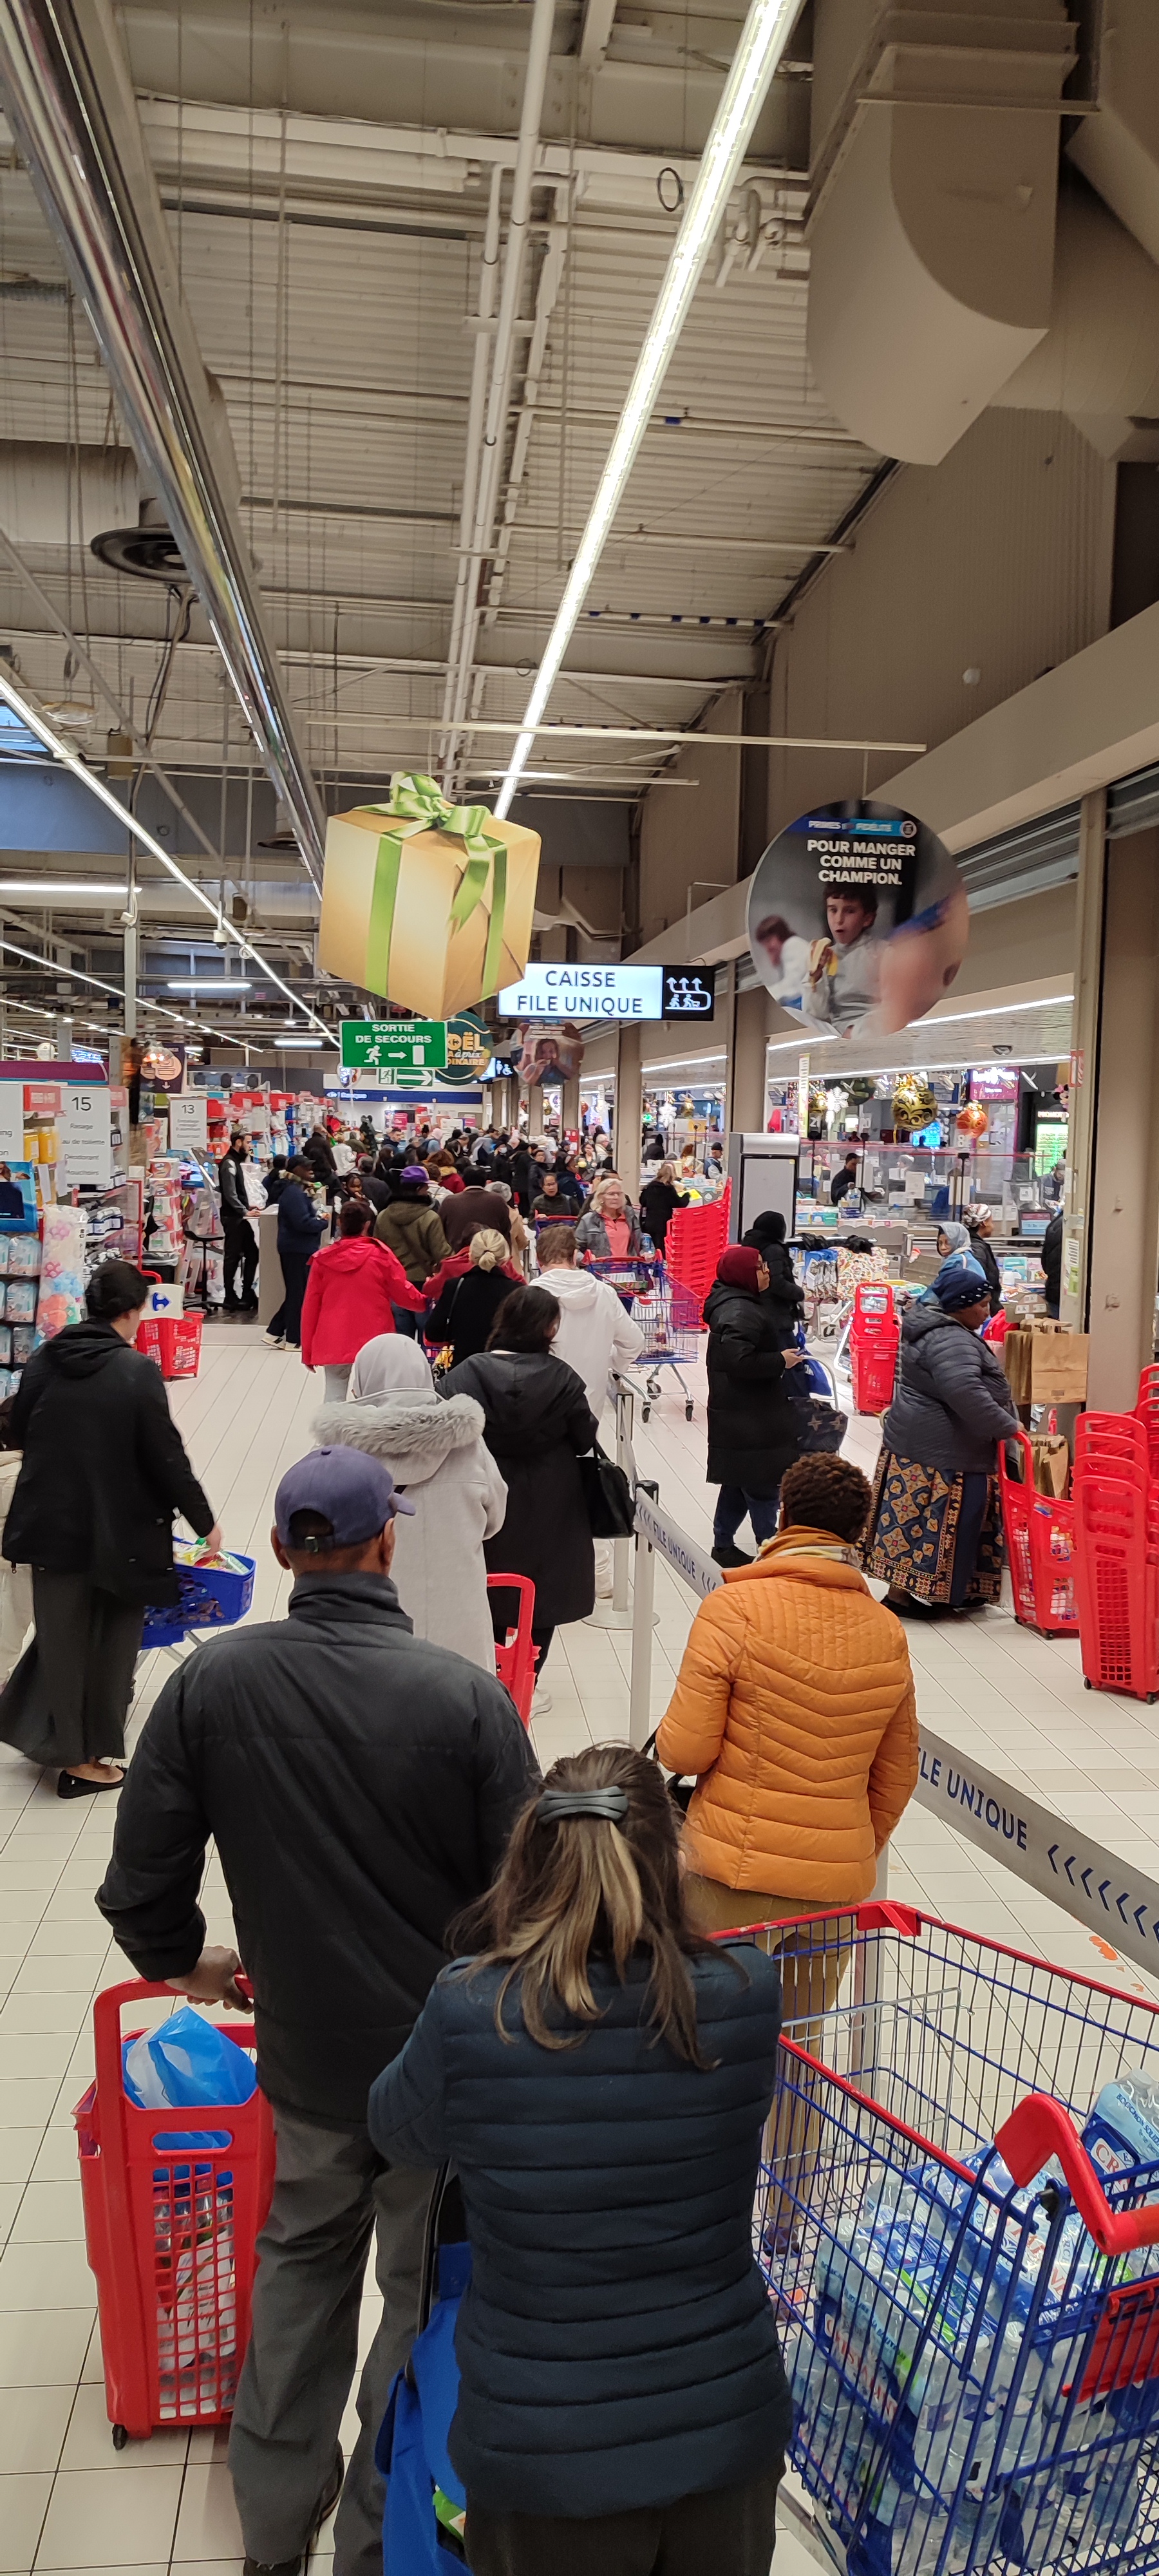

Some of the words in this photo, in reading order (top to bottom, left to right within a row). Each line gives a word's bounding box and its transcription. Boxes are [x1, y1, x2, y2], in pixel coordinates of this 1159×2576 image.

[807, 839, 850, 853] POUR
[853, 841, 916, 857] MANGER
[820, 855, 878, 869] COMME
[880, 858, 902, 870] UN
[818, 869, 903, 886] CHAMPION.
[545, 970, 616, 988] CAISSE
[517, 995, 558, 1012] FILE
[565, 996, 643, 1016] UNIQUE
[372, 1024, 415, 1032] SORTIE
[355, 1035, 372, 1043] DE
[374, 1035, 432, 1043] SECOURS
[448, 1031, 485, 1051] OËL
[71, 1097, 92, 1112] 15
[181, 1104, 195, 1114] 13
[809, 1117, 821, 1128] 21
[653, 1520, 667, 1549] FILE
[668, 1536, 696, 1580] UNIQUE
[918, 1746, 942, 1788] LE
[947, 1768, 1028, 1852] UNIQUE
[1144, 2125, 1159, 2148] SOLID
